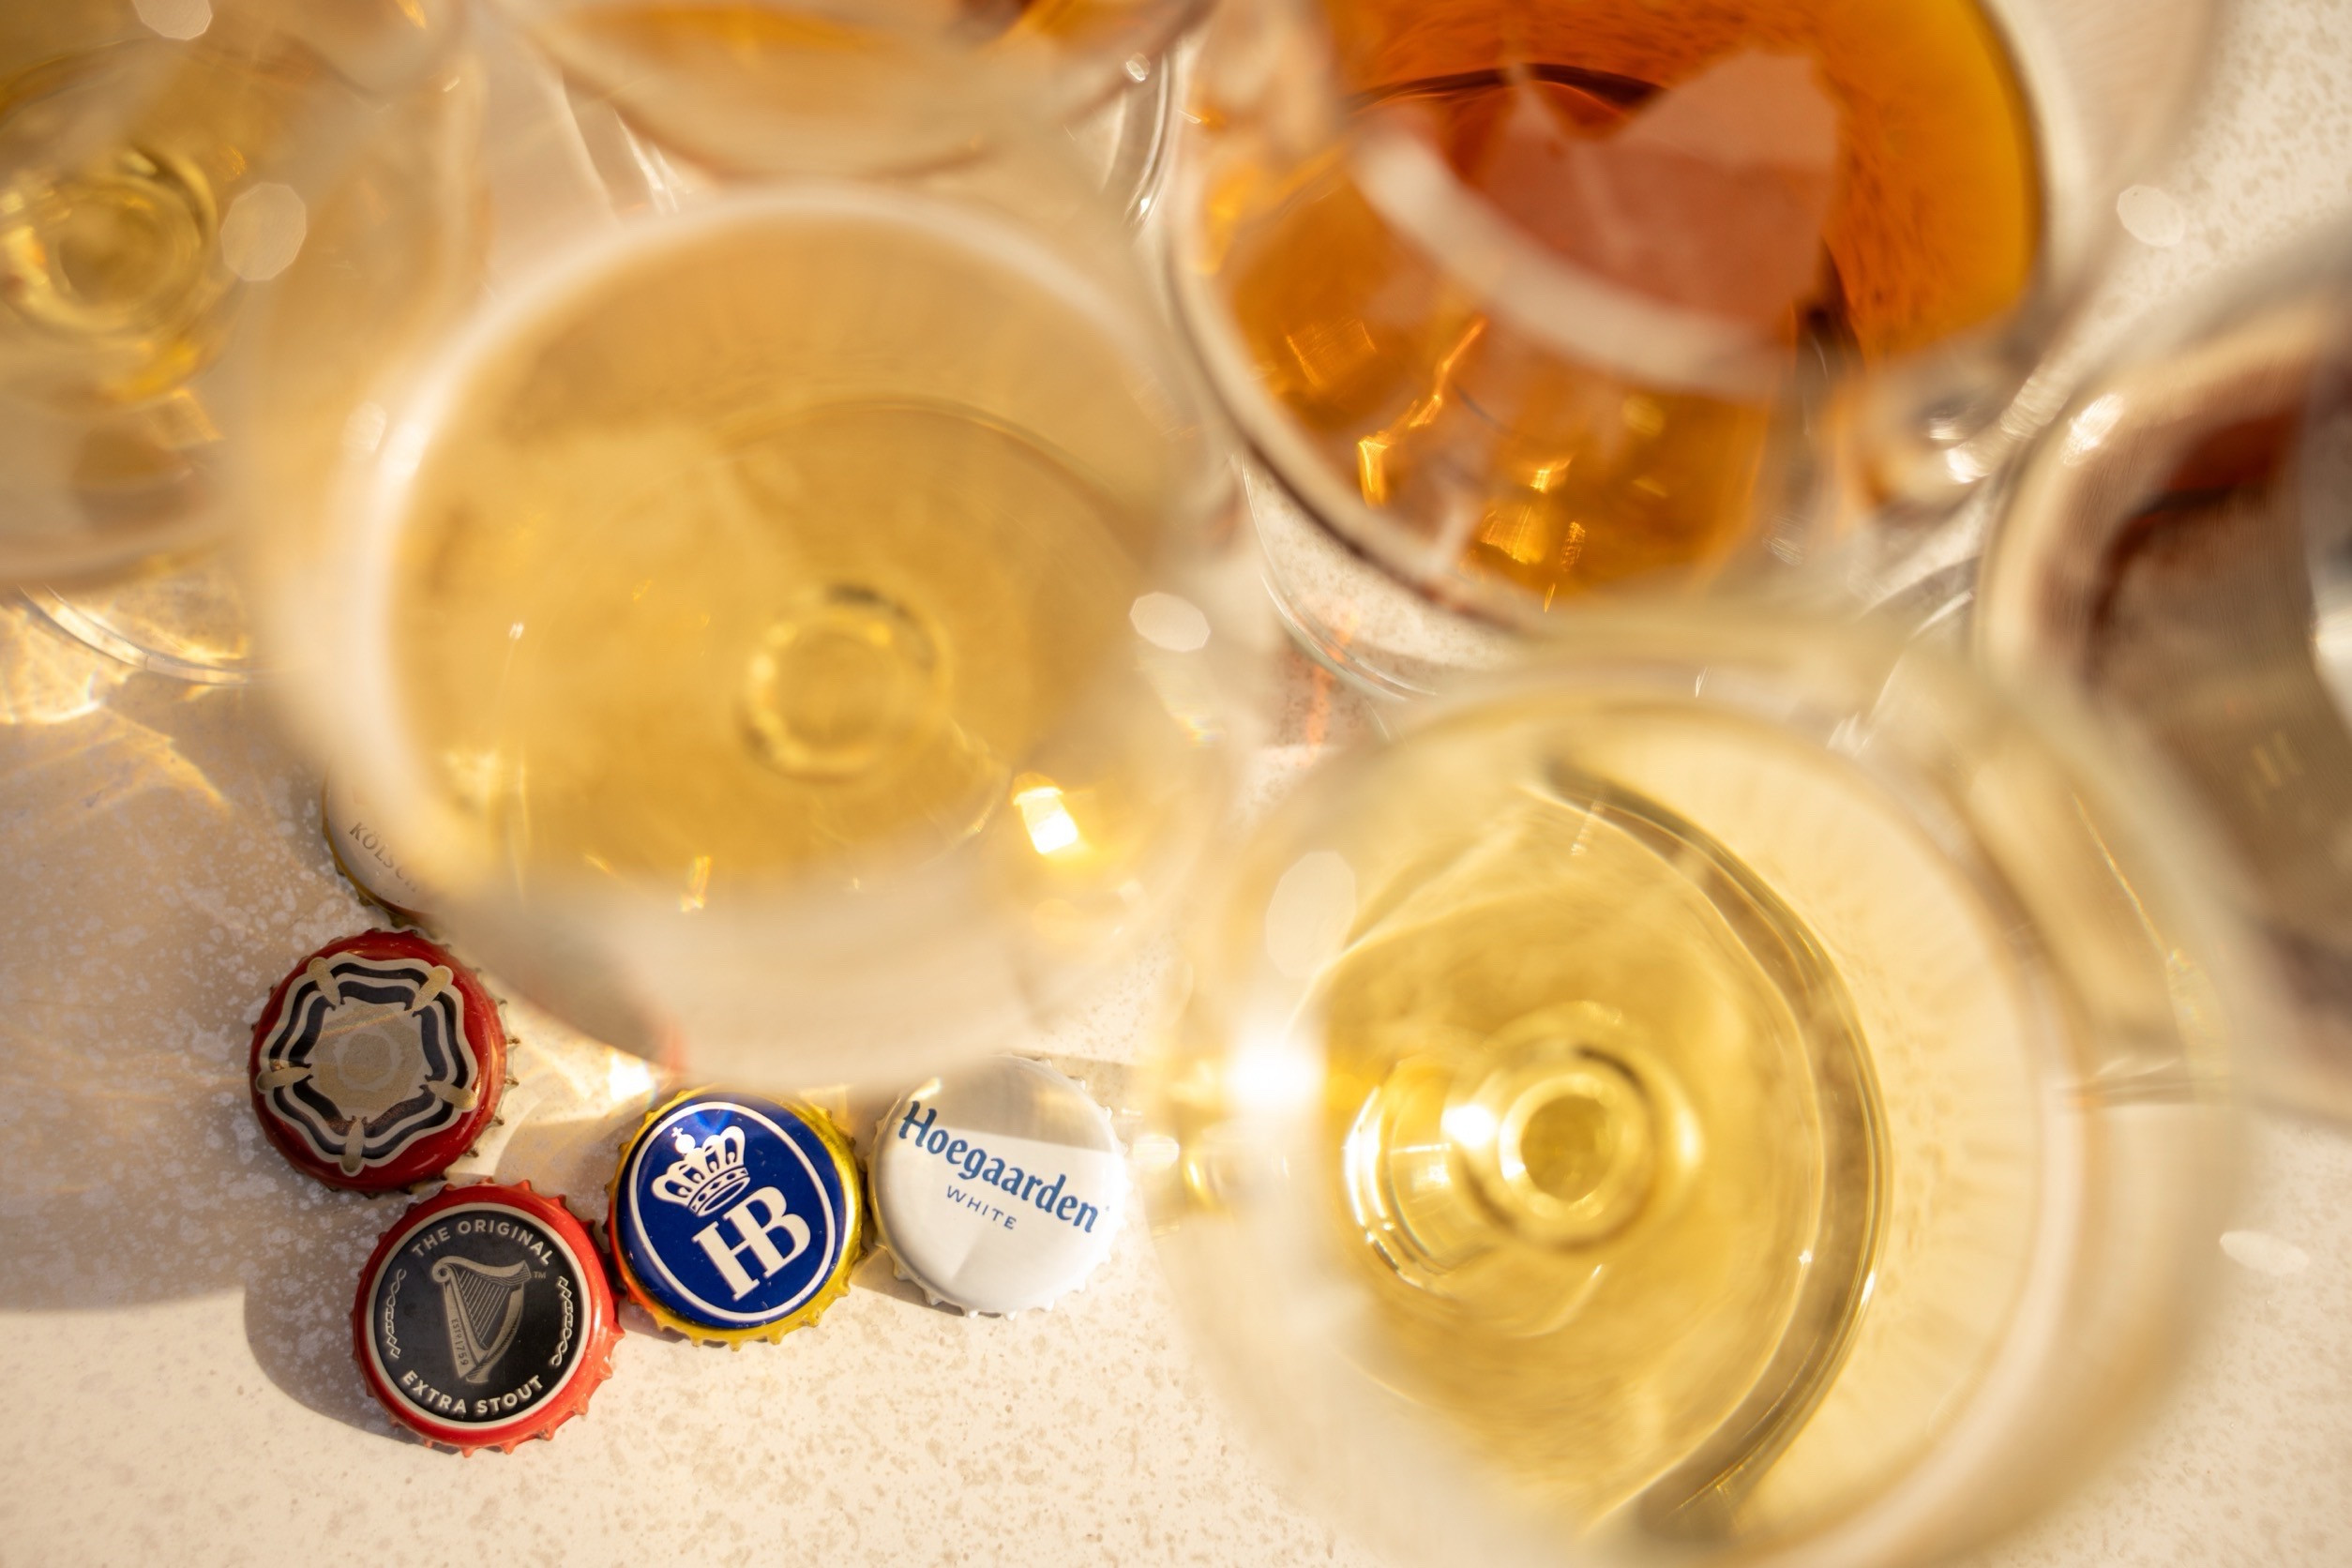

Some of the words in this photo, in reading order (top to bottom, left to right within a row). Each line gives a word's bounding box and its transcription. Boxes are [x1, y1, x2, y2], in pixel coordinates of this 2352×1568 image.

[349, 822, 419, 893] KÖLSC
[897, 1099, 1099, 1234] Hoegaarden
[946, 1184, 1018, 1230] WHITE
[412, 1227, 451, 1258] THE
[458, 1218, 556, 1265] ORIGINAL
[691, 1185, 811, 1302] HB
[401, 1368, 467, 1414] EXTRA
[475, 1374, 544, 1415] STOUT
